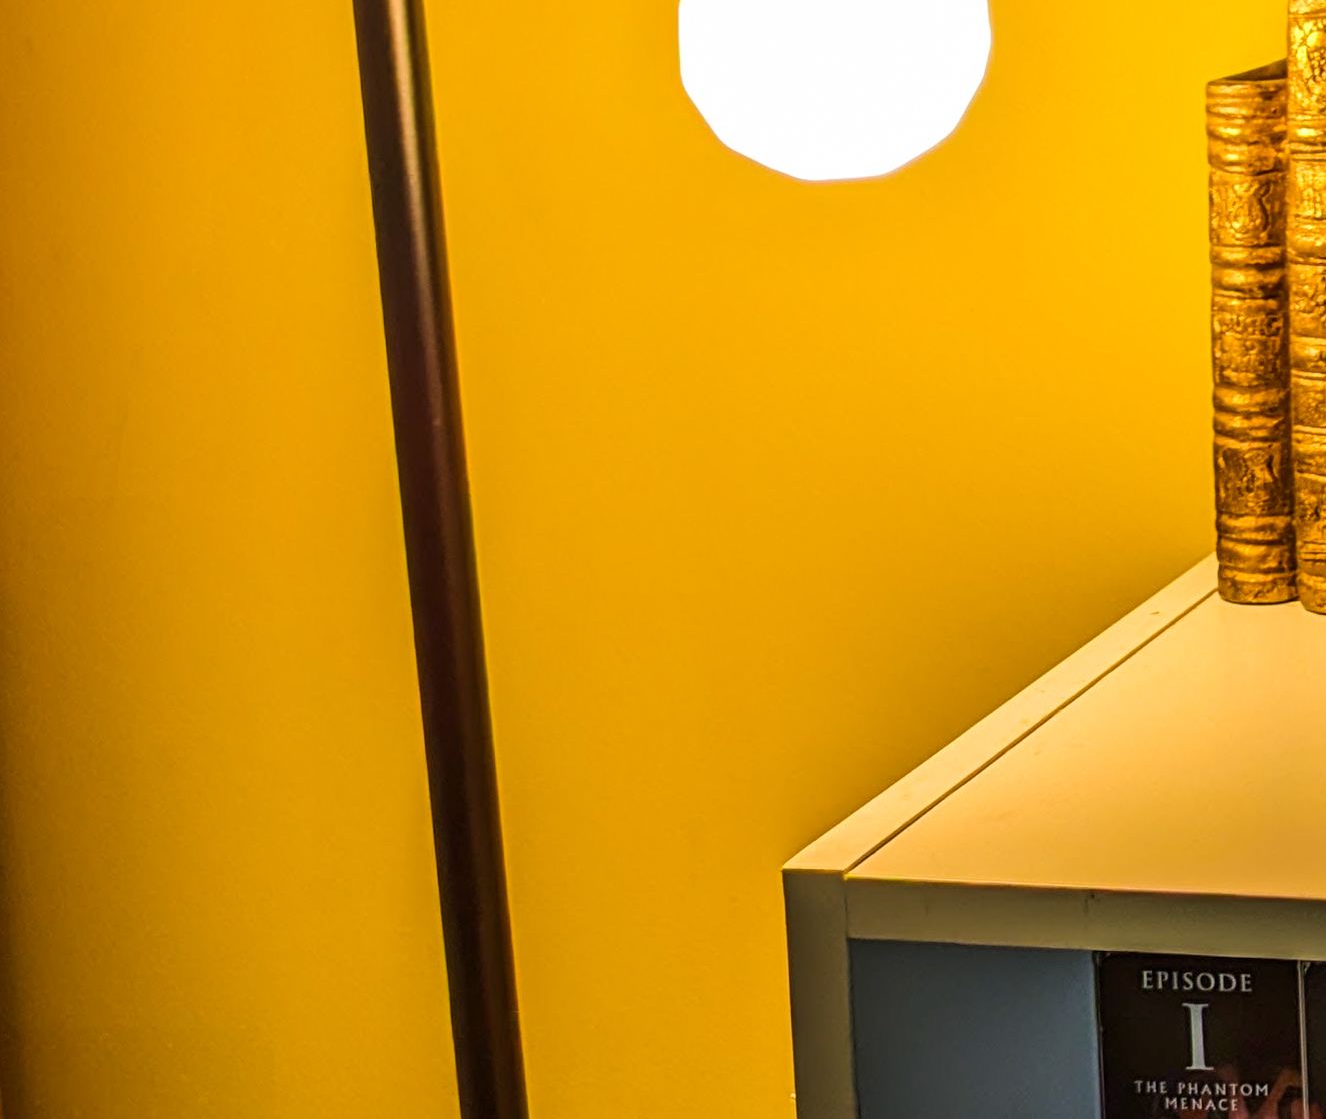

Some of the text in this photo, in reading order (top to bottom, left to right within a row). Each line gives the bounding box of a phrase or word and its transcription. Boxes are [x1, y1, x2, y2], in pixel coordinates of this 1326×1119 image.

[1141, 969, 1253, 993] EPISODE
[1181, 1002, 1215, 1071] I
[1134, 1080, 1270, 1098] THE PHANTOM
[1165, 1097, 1239, 1112] MENACE
